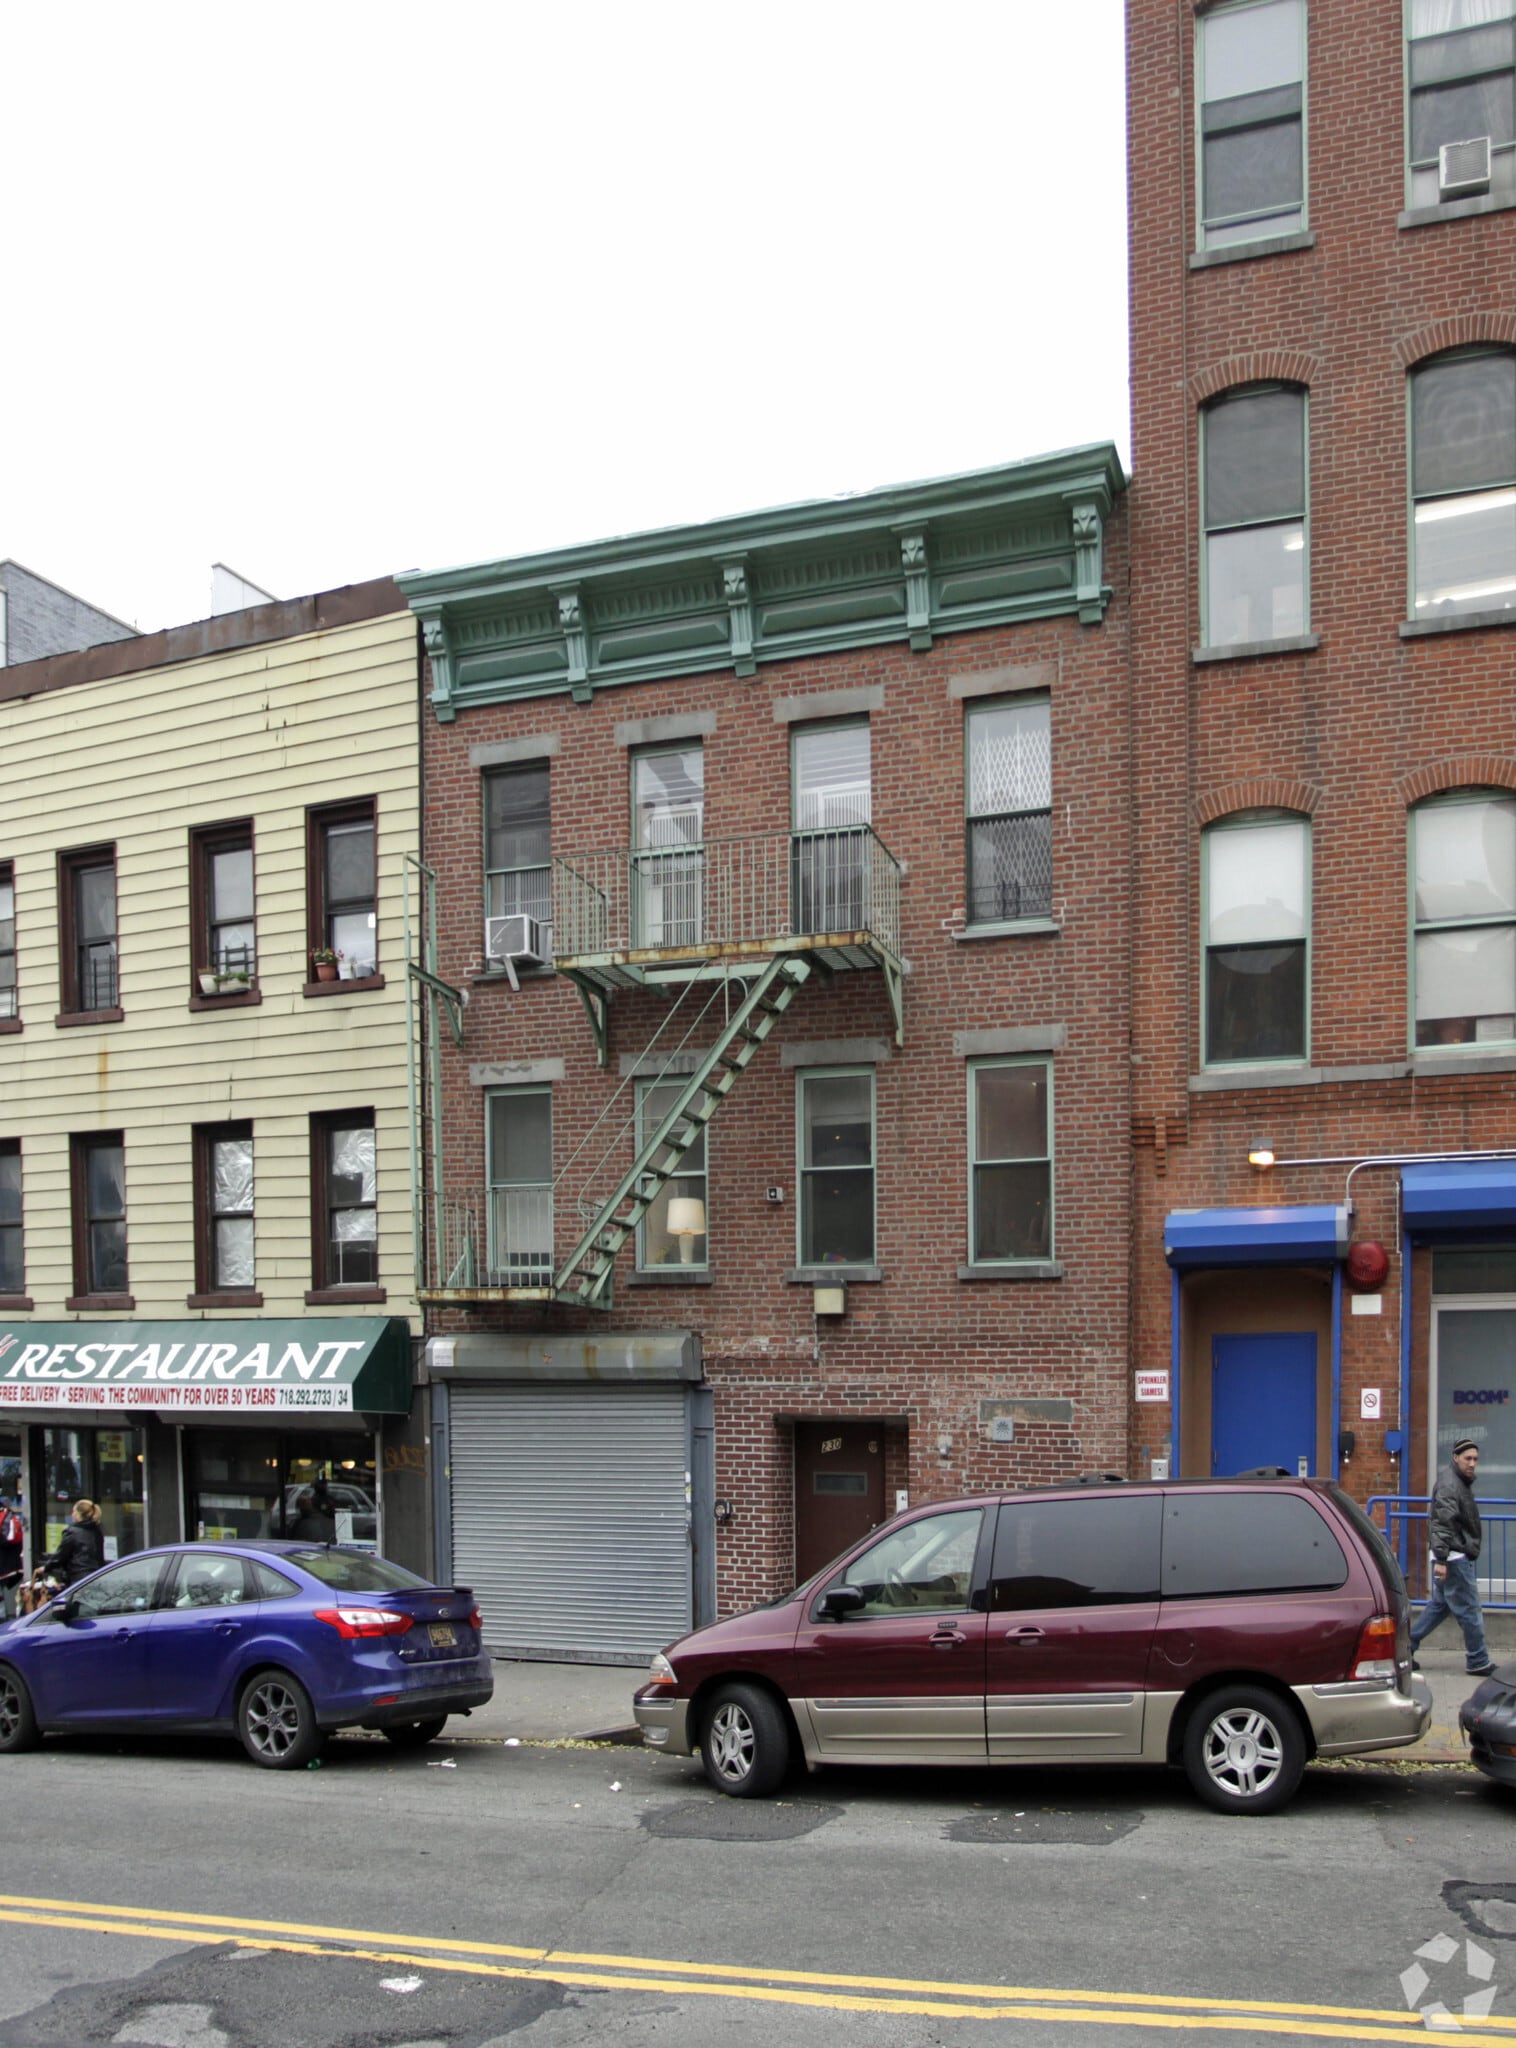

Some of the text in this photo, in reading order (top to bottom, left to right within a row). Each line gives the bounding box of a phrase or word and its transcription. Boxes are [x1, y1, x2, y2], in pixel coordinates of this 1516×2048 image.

[4, 1341, 366, 1379] RESTAURANT
[1137, 1375, 1167, 1384] SPRINKLER
[20, 1385, 60, 1402] DELIVERY
[68, 1386, 105, 1403] SERVING
[108, 1387, 126, 1404] THE
[127, 1387, 181, 1404] COMMUNITY
[183, 1387, 202, 1405] FOR
[204, 1387, 229, 1405] OVER
[231, 1388, 243, 1405] 50
[245, 1387, 276, 1405] YEARS
[1141, 1387, 1164, 1396] SIAMESE
[1453, 1389, 1511, 1404] BOOM!
[823, 1438, 841, 1452] 230
